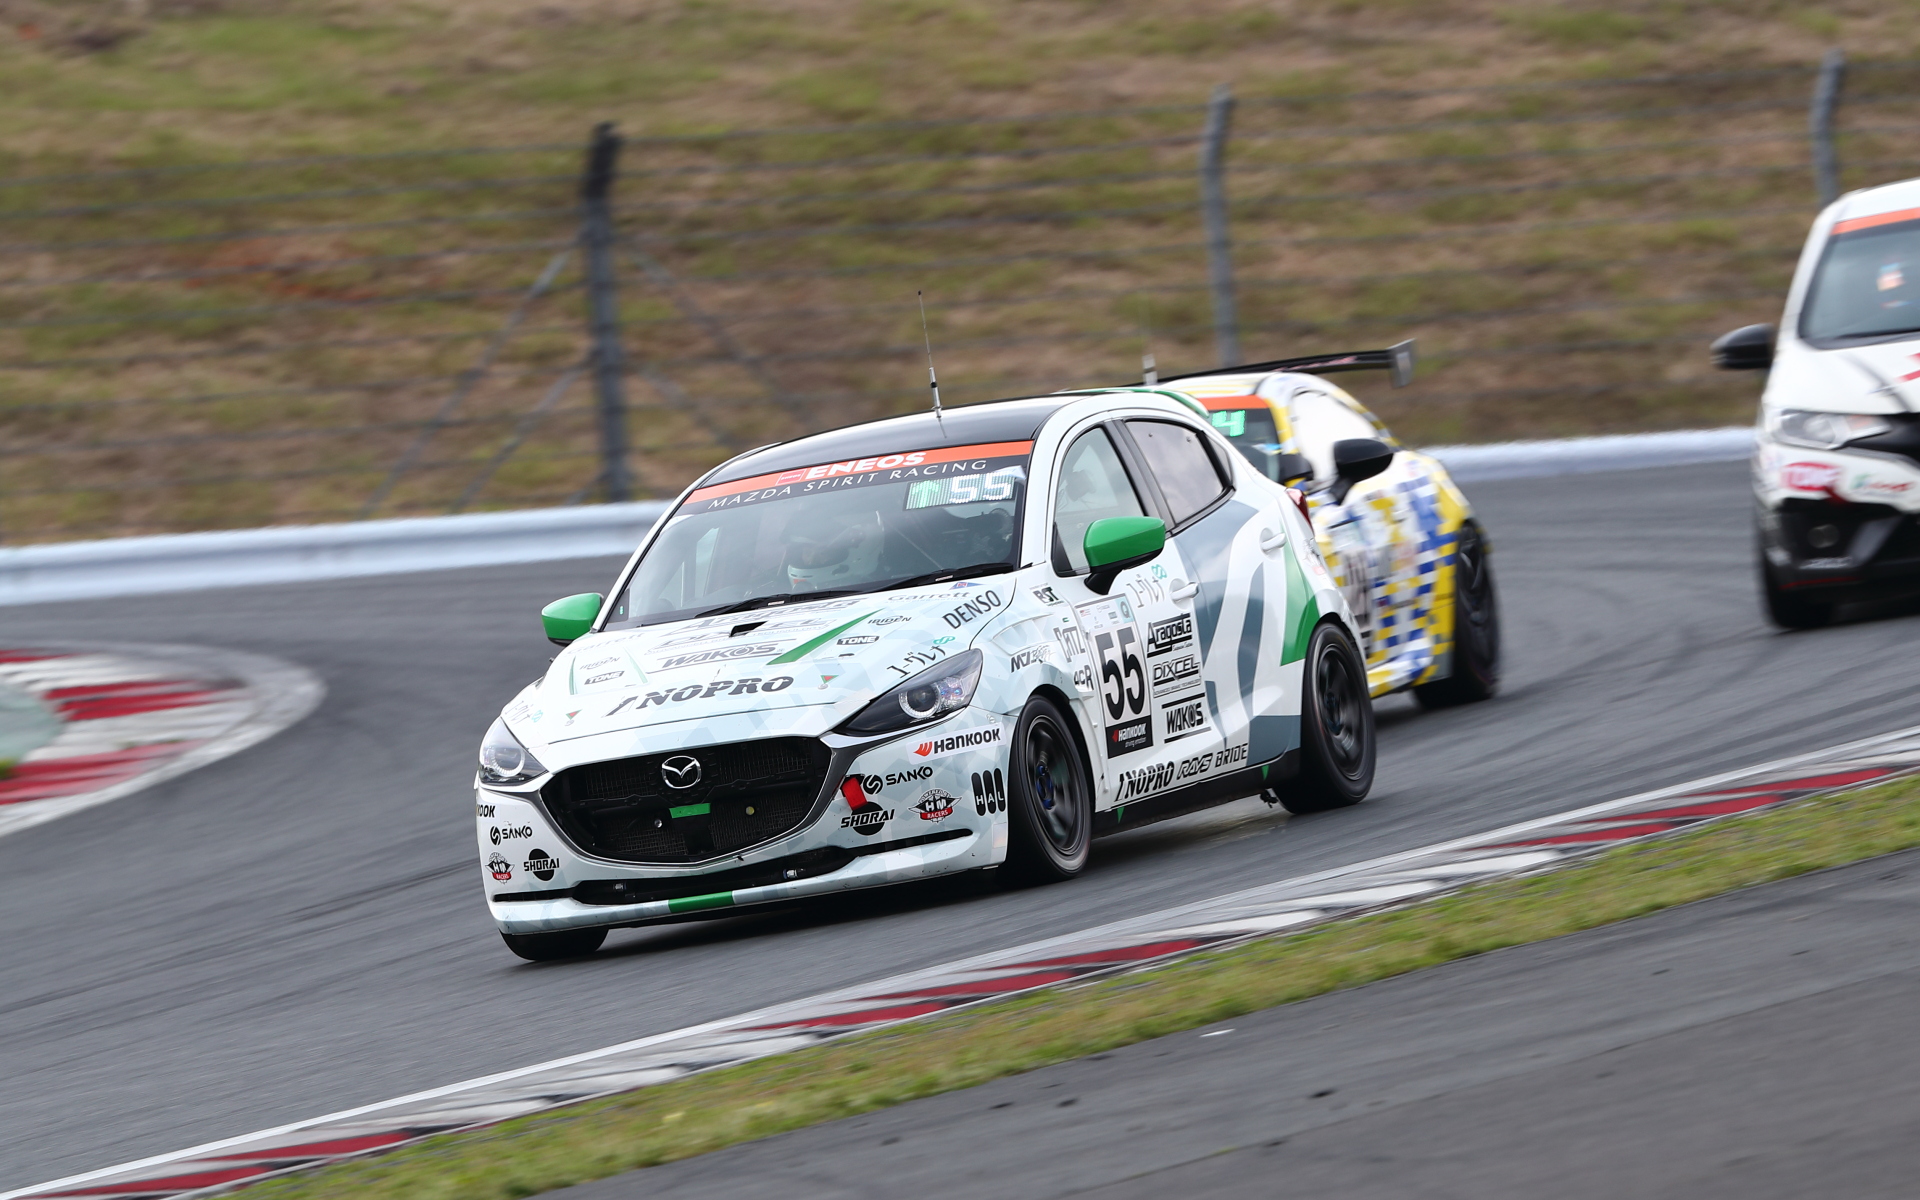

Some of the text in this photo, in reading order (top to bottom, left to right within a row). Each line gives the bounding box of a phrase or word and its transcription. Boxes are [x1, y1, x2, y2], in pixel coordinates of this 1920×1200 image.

[805, 452, 927, 480] ENEOS
[707, 460, 987, 510] MAZDA SPIRIT RACING
[949, 471, 1012, 504] 55
[868, 615, 912, 626] IBIDEN
[942, 590, 1002, 630] DENSO
[839, 636, 878, 645] TONE
[1147, 616, 1192, 652] Aragosta
[586, 671, 624, 684] TONE
[1094, 626, 1146, 721] 55
[1153, 656, 1200, 681] DIXCEL
[1177, 753, 1213, 780] RAYS
[1215, 743, 1248, 768] BRIDE
[885, 766, 933, 786] SANKO
[976, 791, 1004, 806] HAL
[840, 809, 896, 828] SHORAI
[927, 810, 949, 819] RACERS
[502, 825, 533, 840] SANKO
[523, 858, 560, 872] SHORAI
